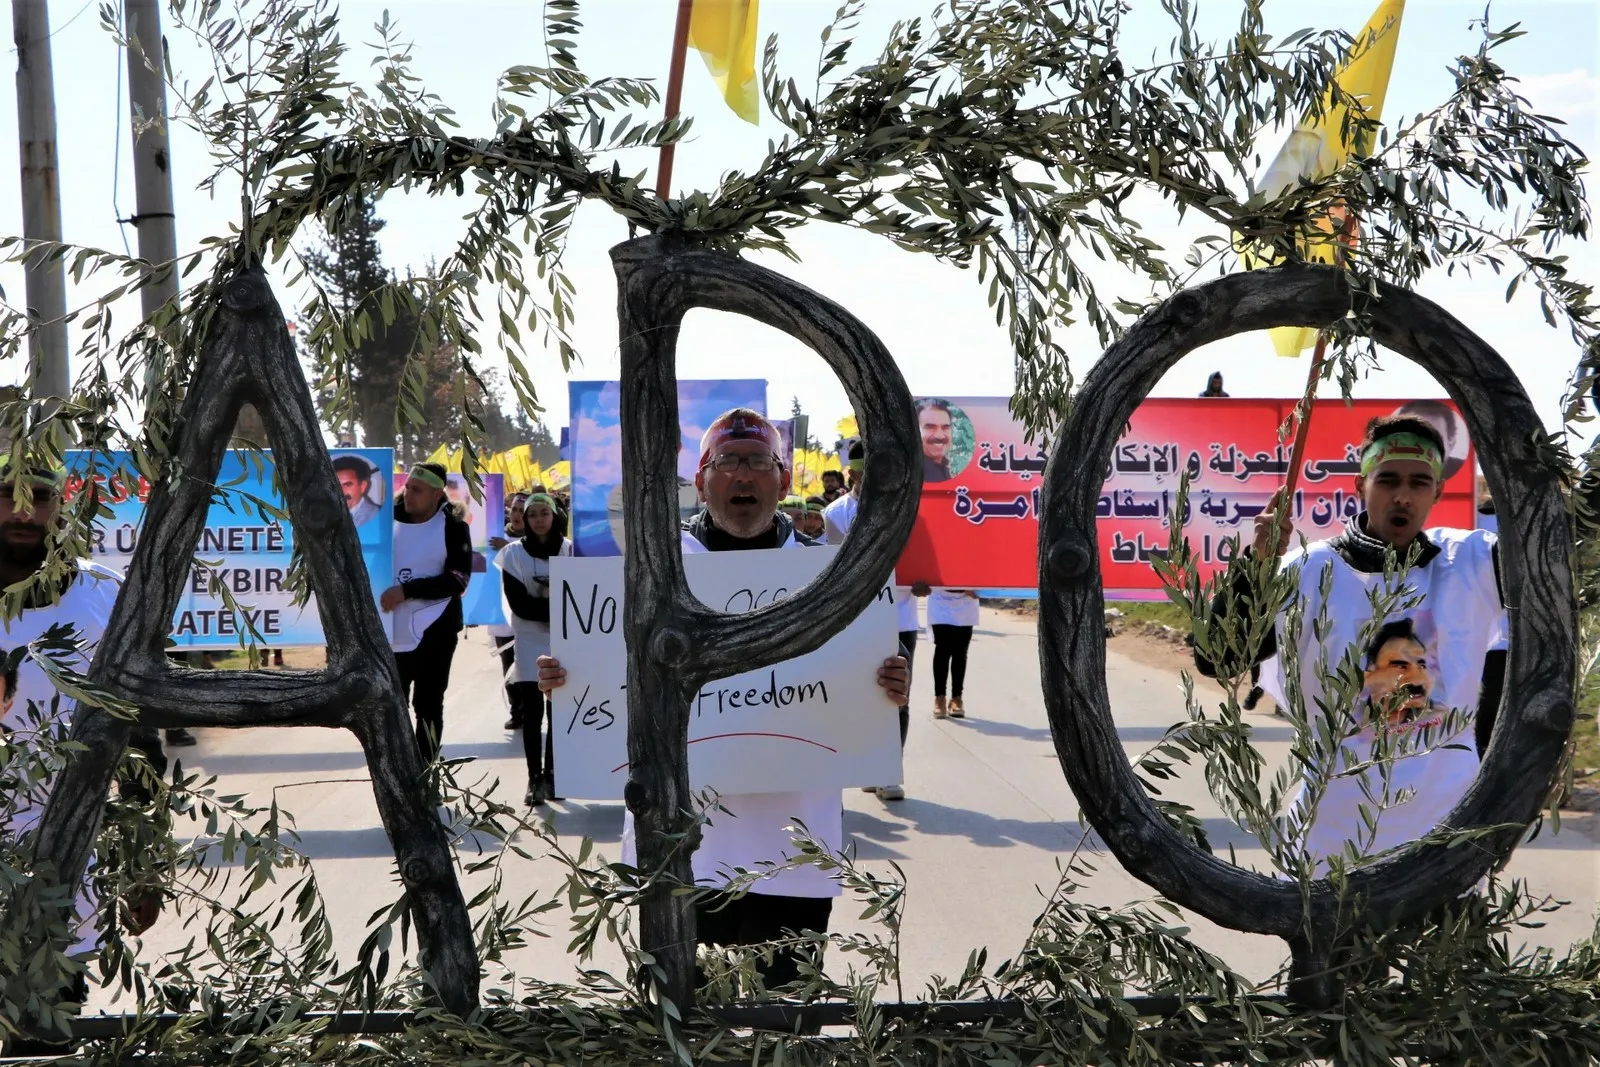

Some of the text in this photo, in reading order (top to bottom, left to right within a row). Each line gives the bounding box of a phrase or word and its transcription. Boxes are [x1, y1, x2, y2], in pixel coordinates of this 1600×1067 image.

[979, 442, 1049, 479] خيانة
[1305, 443, 1361, 481] فى
[956, 487, 1040, 522] امرة
[1312, 490, 1365, 527] وان
[562, 580, 616, 640] No
[567, 684, 615, 735] Yes
